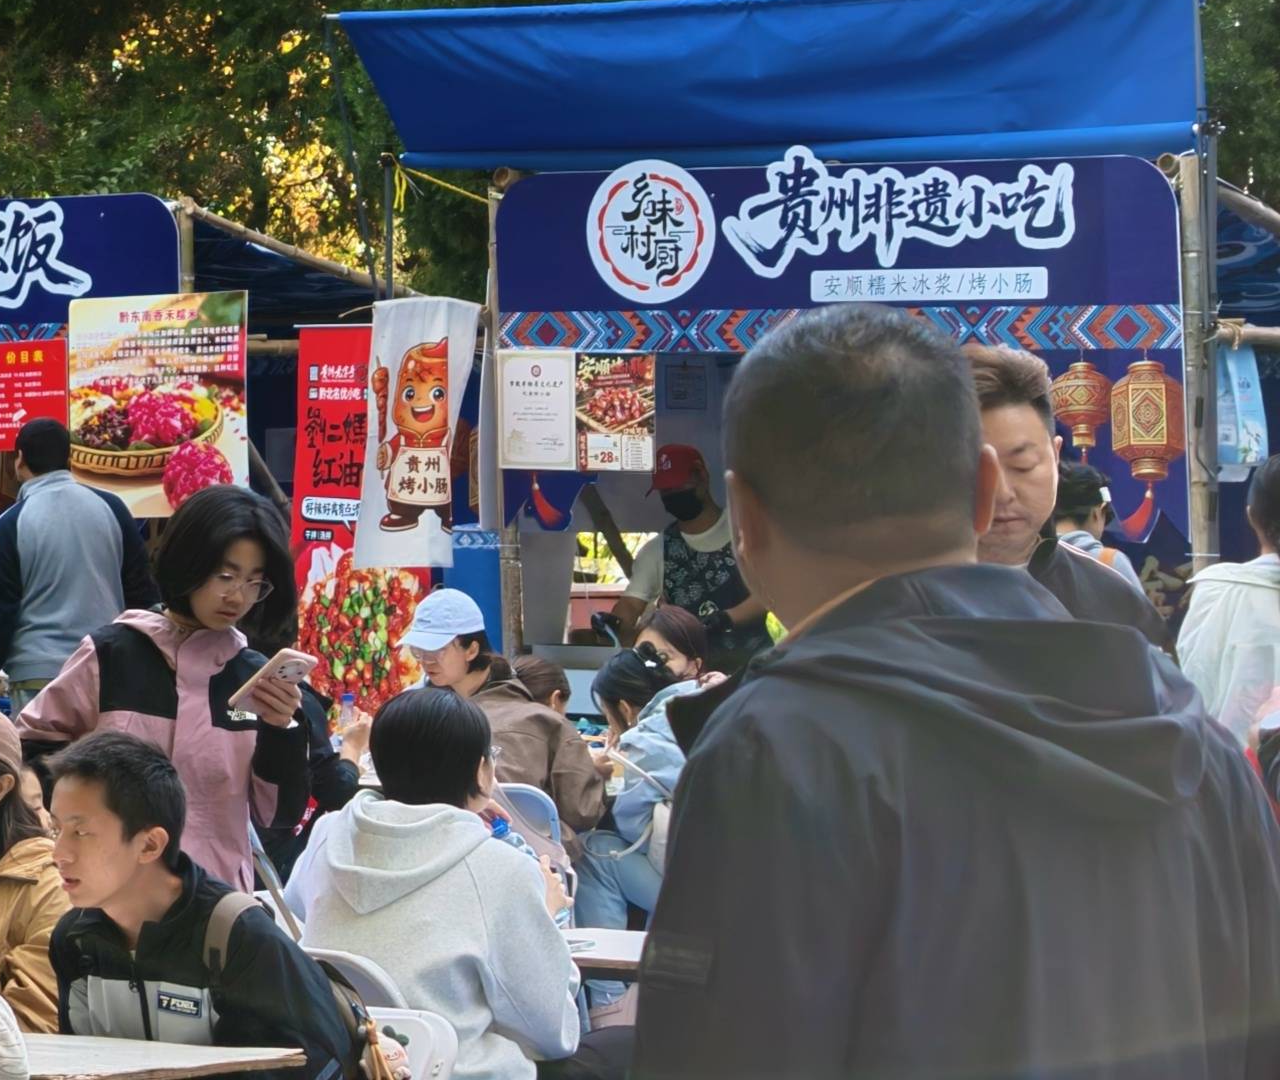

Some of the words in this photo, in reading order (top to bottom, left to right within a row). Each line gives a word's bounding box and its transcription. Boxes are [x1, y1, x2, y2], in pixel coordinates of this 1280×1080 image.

[730, 154, 1066, 260] 贵州非遗小吃
[822, 271, 1034, 298] 安顺糯米冰浆/烤小肠
[5, 350, 44, 365] 价目表
[404, 455, 441, 474] 贵州
[397, 476, 448, 496] 烤小肠
